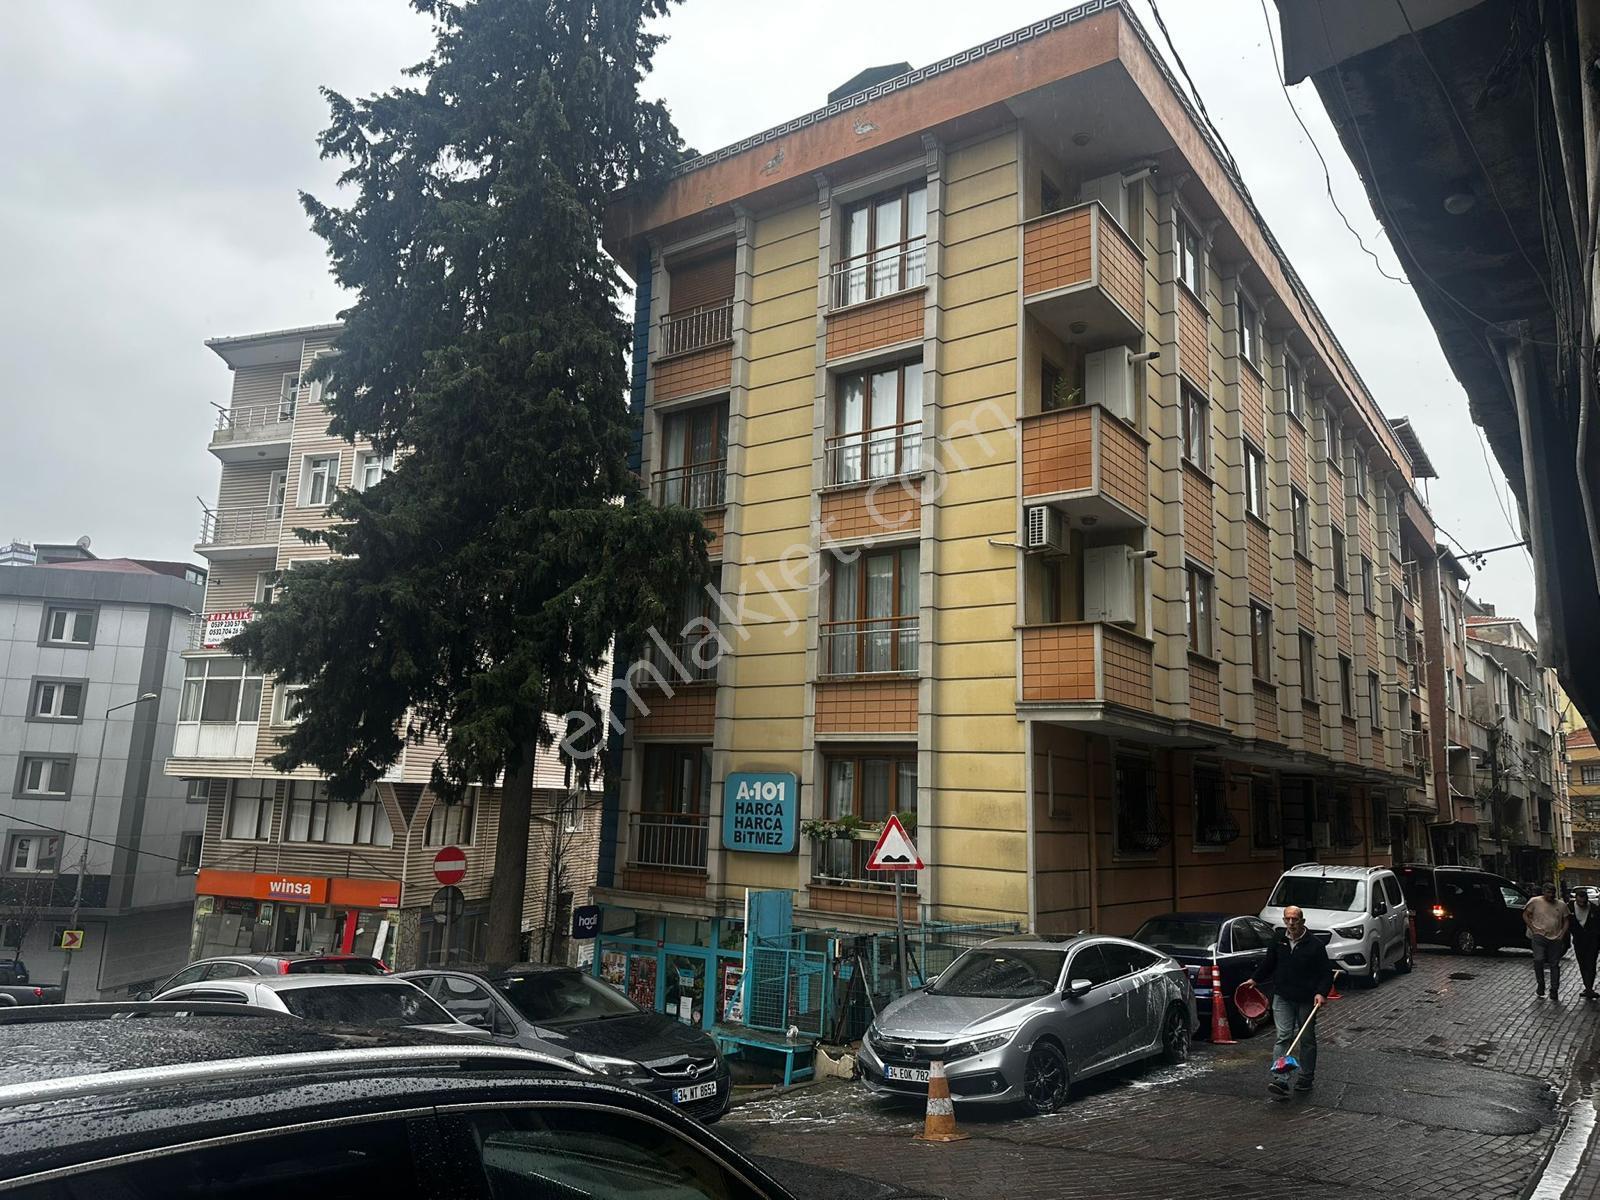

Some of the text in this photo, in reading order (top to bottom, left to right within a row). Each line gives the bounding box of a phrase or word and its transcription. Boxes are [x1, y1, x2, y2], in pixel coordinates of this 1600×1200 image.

[735, 802, 783, 816] HARCA
[734, 816, 783, 831] HARCA
[270, 878, 311, 895] winsa
[889, 1066, 929, 1081] 34 EOK 782
[678, 1089, 688, 1101] 34
